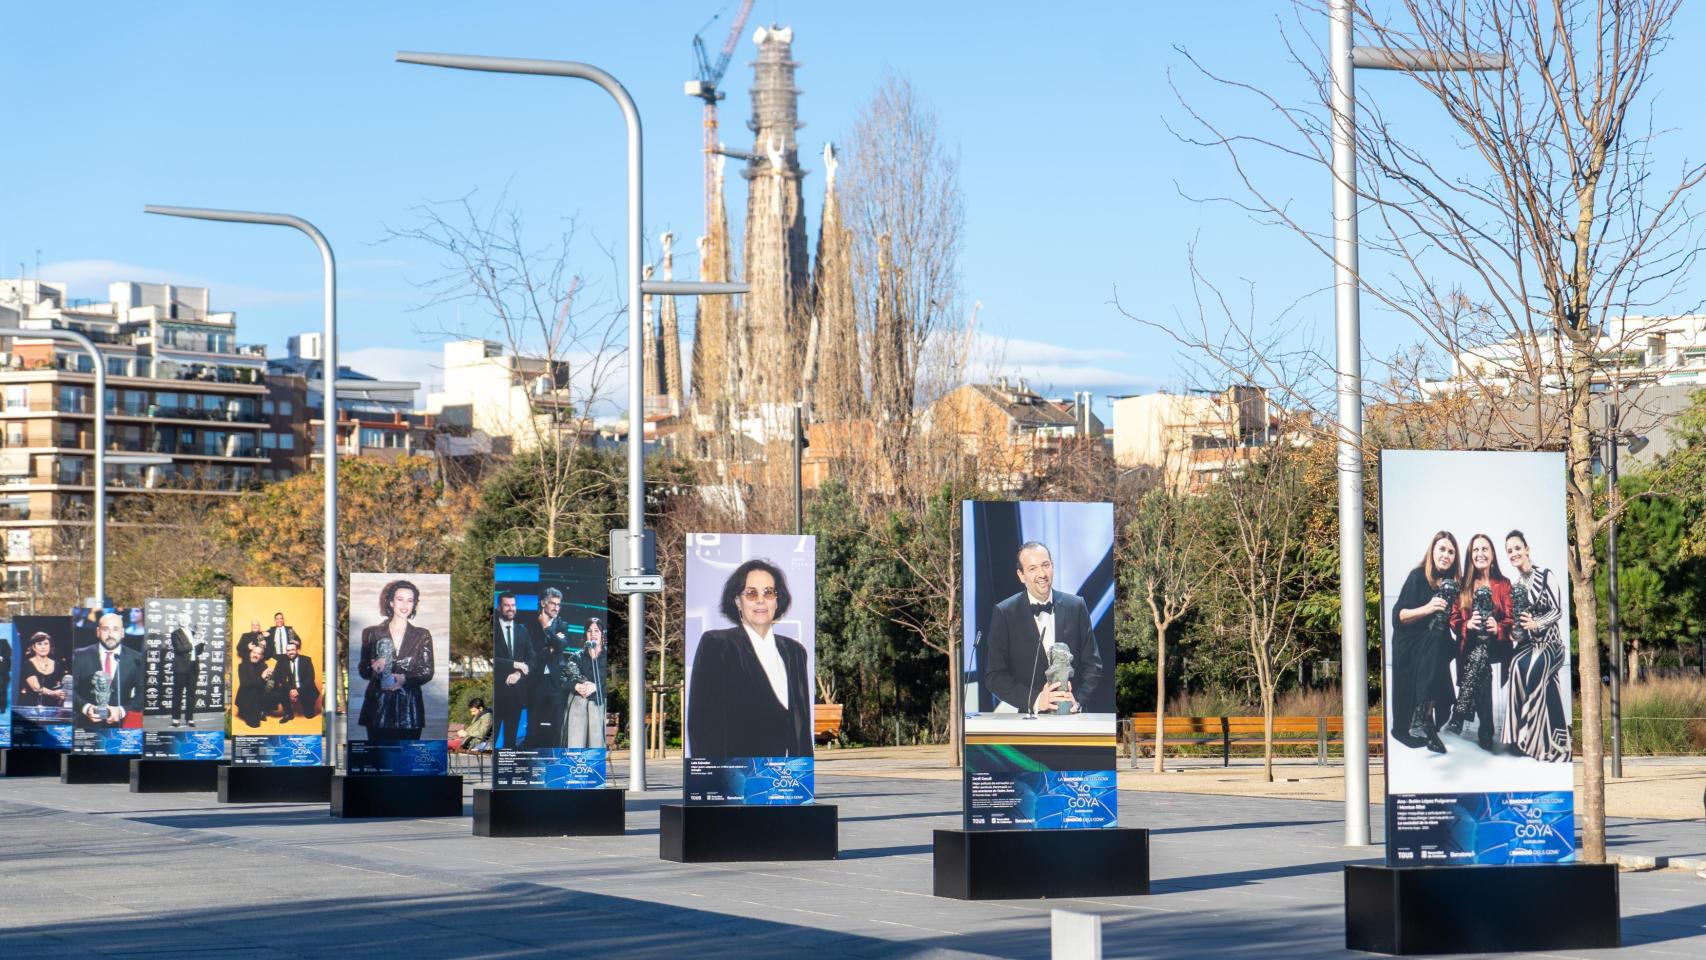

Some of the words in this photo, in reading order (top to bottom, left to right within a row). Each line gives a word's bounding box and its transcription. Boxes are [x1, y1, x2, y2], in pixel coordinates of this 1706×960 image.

[772, 779, 799, 787] GOYA
[1078, 784, 1090, 792] 40
[1068, 797, 1100, 808] GOYA
[1527, 808, 1542, 818] 40
[1515, 824, 1553, 838] GOYA
